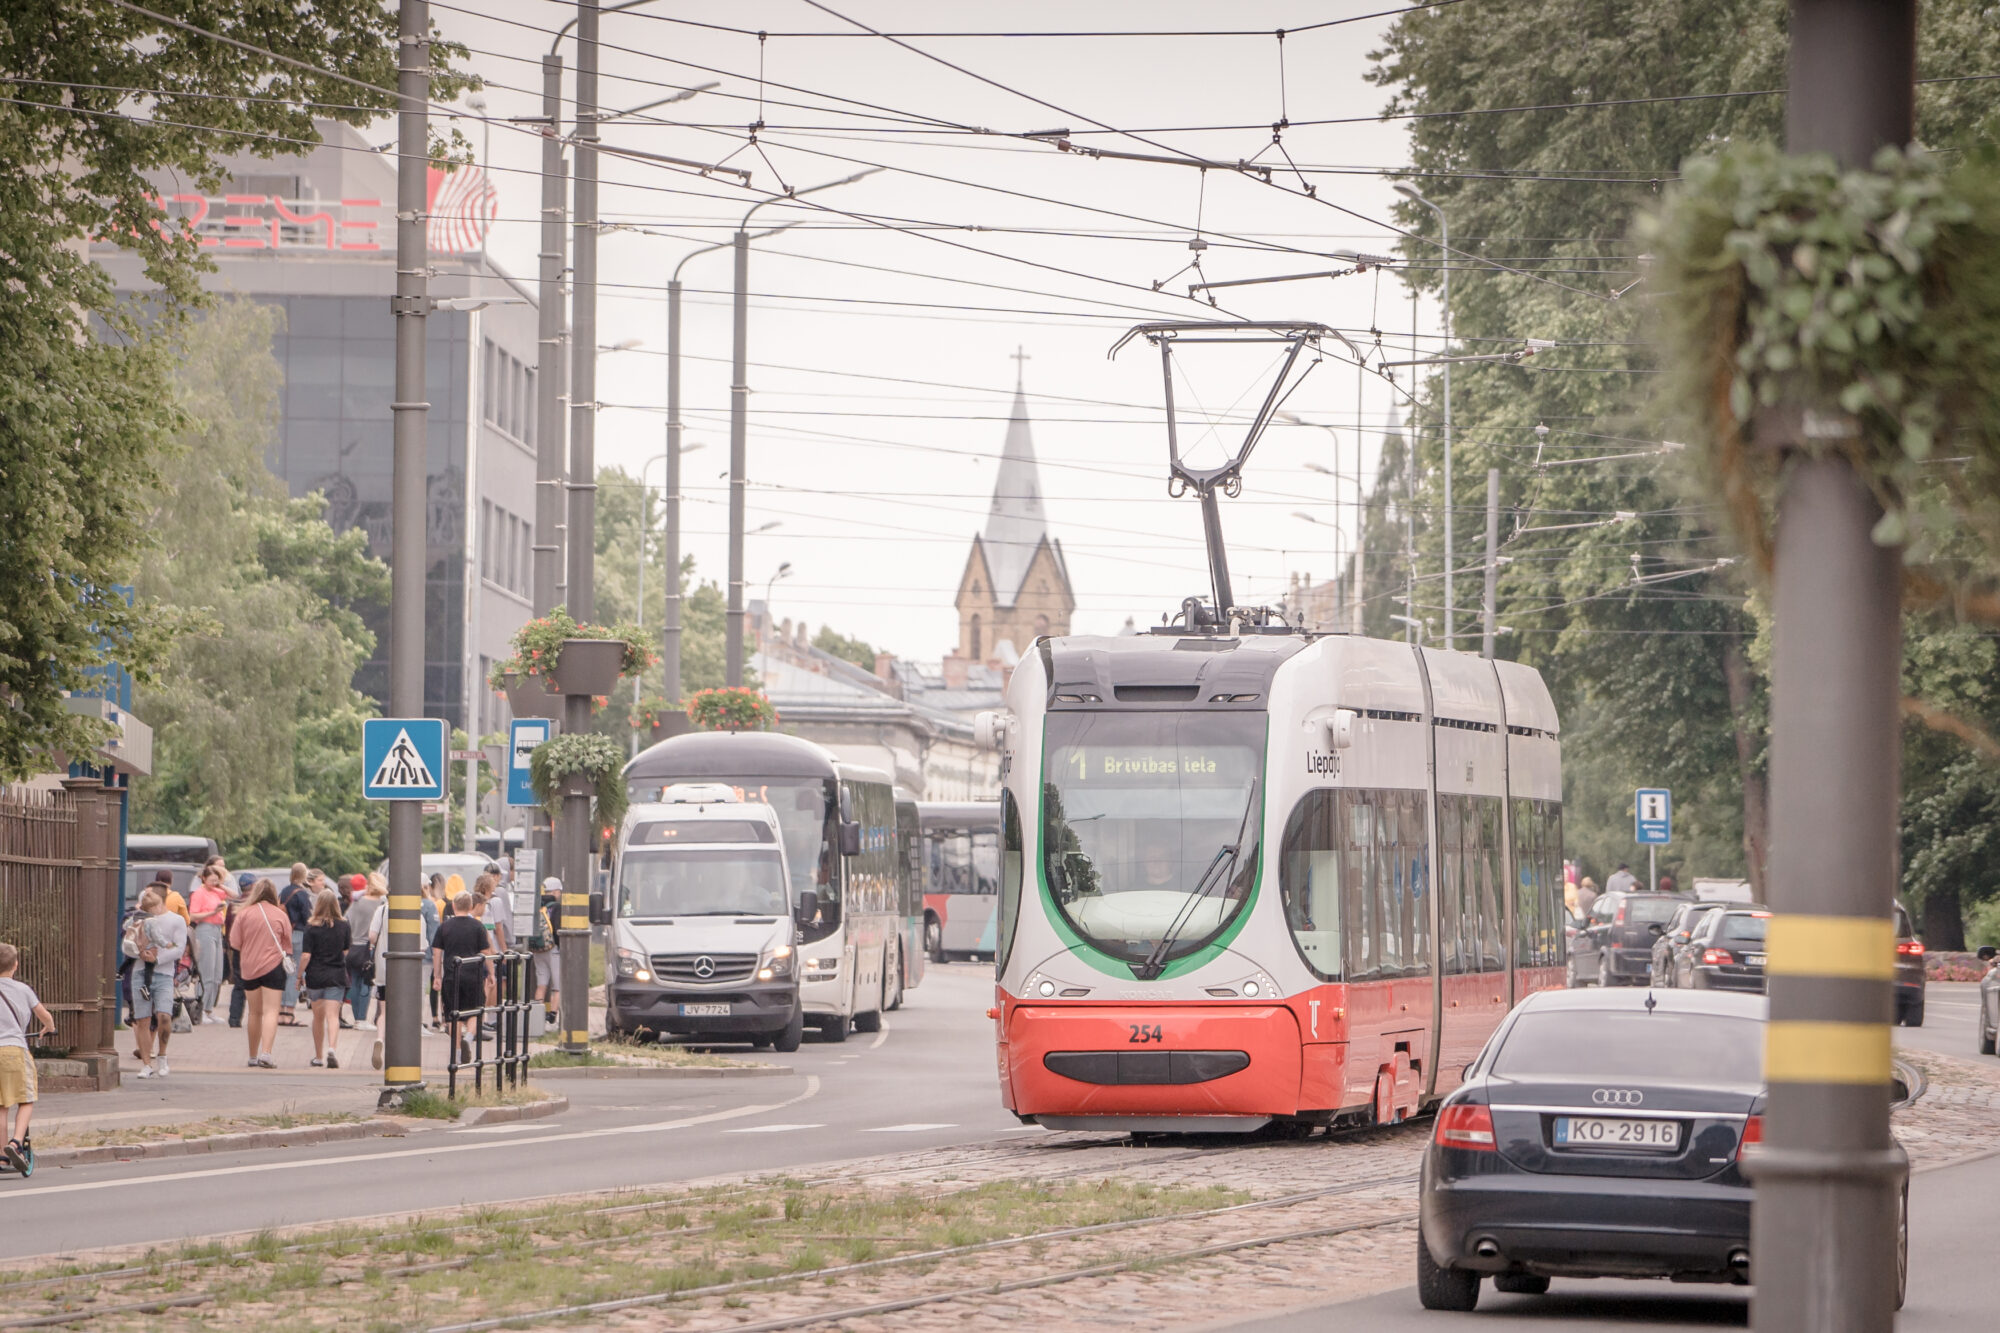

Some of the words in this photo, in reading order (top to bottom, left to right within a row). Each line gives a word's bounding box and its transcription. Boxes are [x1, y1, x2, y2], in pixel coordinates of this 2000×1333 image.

[1070, 748, 1087, 780] 1
[1104, 756, 1177, 774] Brīvības
[1184, 756, 1217, 774] iela
[1129, 1024, 1163, 1043] 254
[1572, 1120, 1674, 1143] KO-2916
